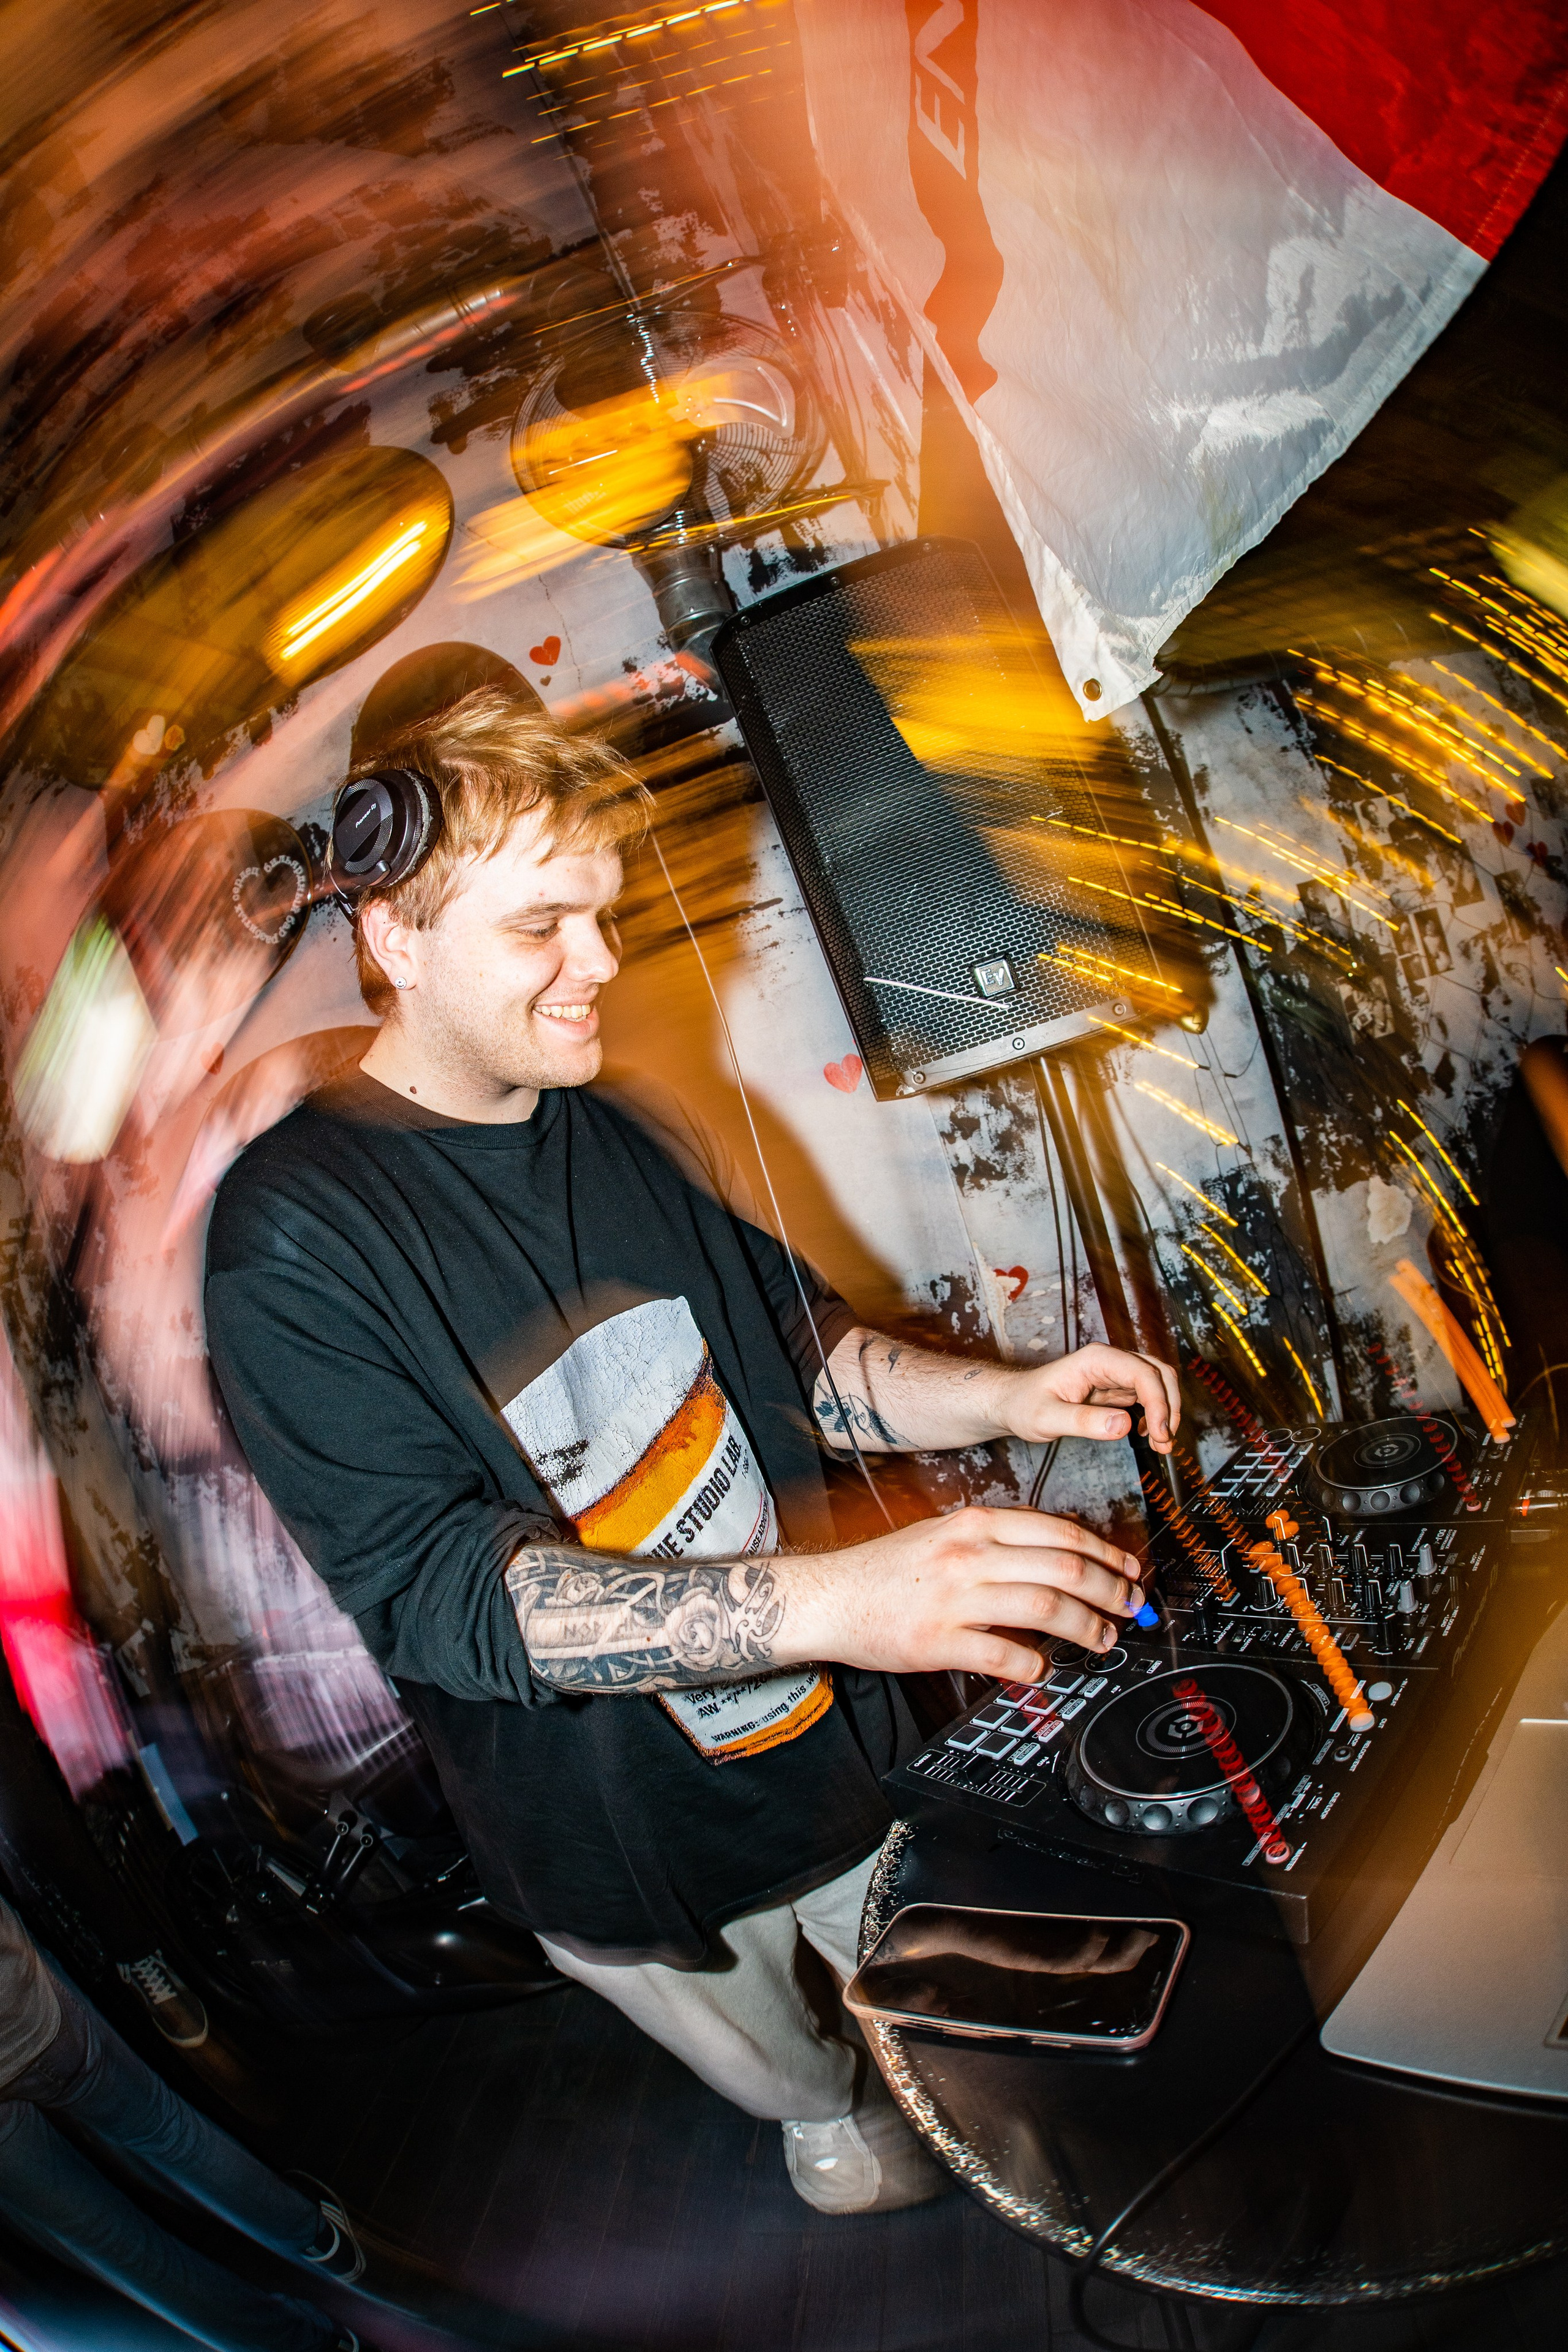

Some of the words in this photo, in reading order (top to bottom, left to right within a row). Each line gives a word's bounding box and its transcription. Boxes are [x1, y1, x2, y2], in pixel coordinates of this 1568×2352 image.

[355, 809, 371, 829] Pioneer
[232, 867, 260, 902] сердец
[279, 914, 296, 938] бар
[676, 1468, 731, 1544] STUDIO
[720, 1434, 742, 1477] LAB
[1385, 1583, 1394, 1593] LEVEL
[1389, 1581, 1401, 1596] CHANNEL
[1276, 1597, 1287, 1609] FILTER
[1213, 1621, 1235, 1644] LEVEL/DEPTH
[1278, 1634, 1291, 1646] SELECT
[1319, 1635, 1327, 1644] BEAT
[1238, 1638, 1252, 1651] MASTER
[1404, 1638, 1415, 1650] LEVEL
[1416, 1636, 1428, 1653] MASTER
[685, 1687, 717, 1705] Very
[1110, 1684, 1120, 1694] REV
[711, 1720, 761, 1742] WARNING:
[761, 1701, 789, 1723] using
[788, 1684, 807, 1703] this
[1049, 1721, 1060, 1730] BEAT
[1377, 1717, 1387, 1729] OUT
[1041, 1728, 1051, 1737] JUMP
[1350, 1733, 1362, 1747] LOOP
[1018, 1744, 1035, 1759] SAMPLER
[1349, 1740, 1371, 1772] RELOOP/EXIT
[913, 1752, 932, 1767] TEMPO
[1036, 1756, 1049, 1766] FWD
[1309, 1796, 1322, 1811] CALL
[1319, 1792, 1340, 1819] CUE/LOOP
